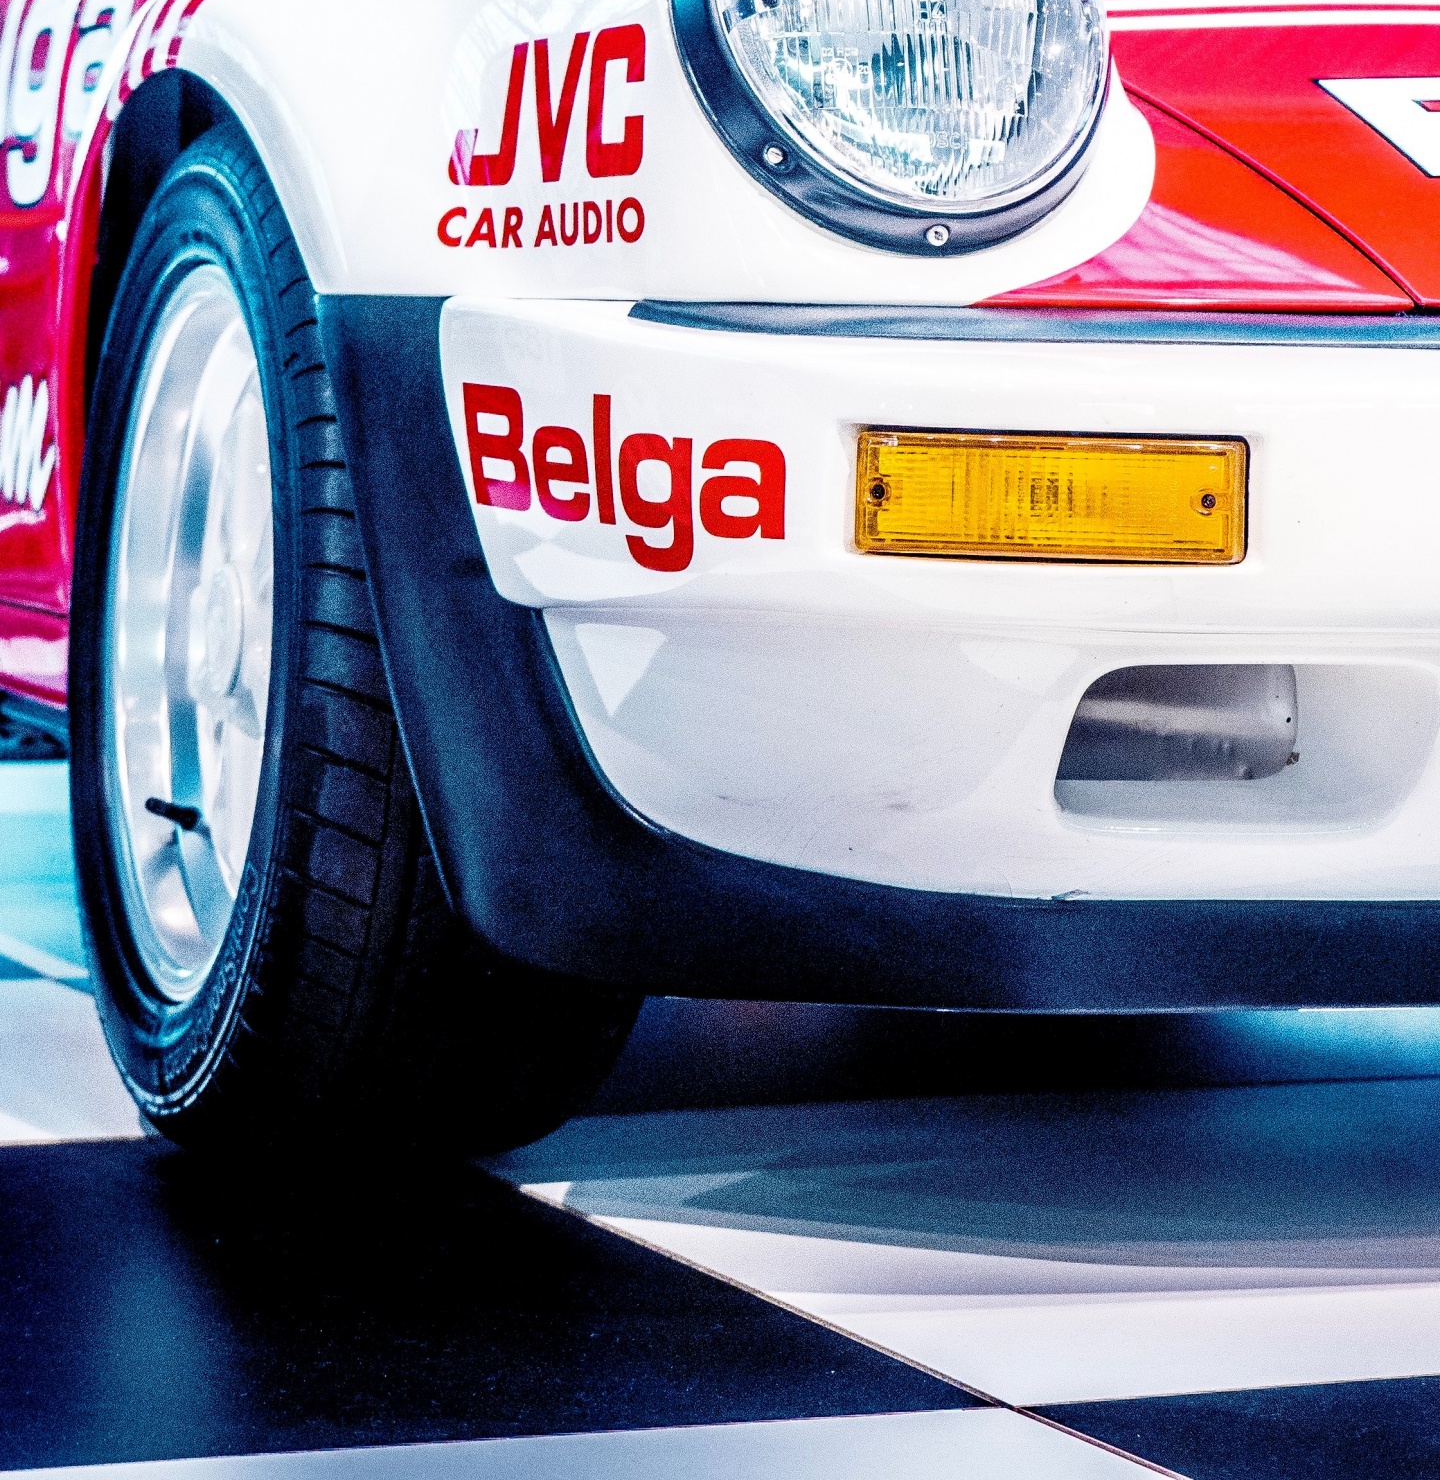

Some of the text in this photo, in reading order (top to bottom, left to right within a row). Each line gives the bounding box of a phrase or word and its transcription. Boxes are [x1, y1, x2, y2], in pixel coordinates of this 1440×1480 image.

[448, 23, 645, 186] JVC
[437, 197, 645, 248] CAR AUDIO
[463, 382, 787, 573] Belga
